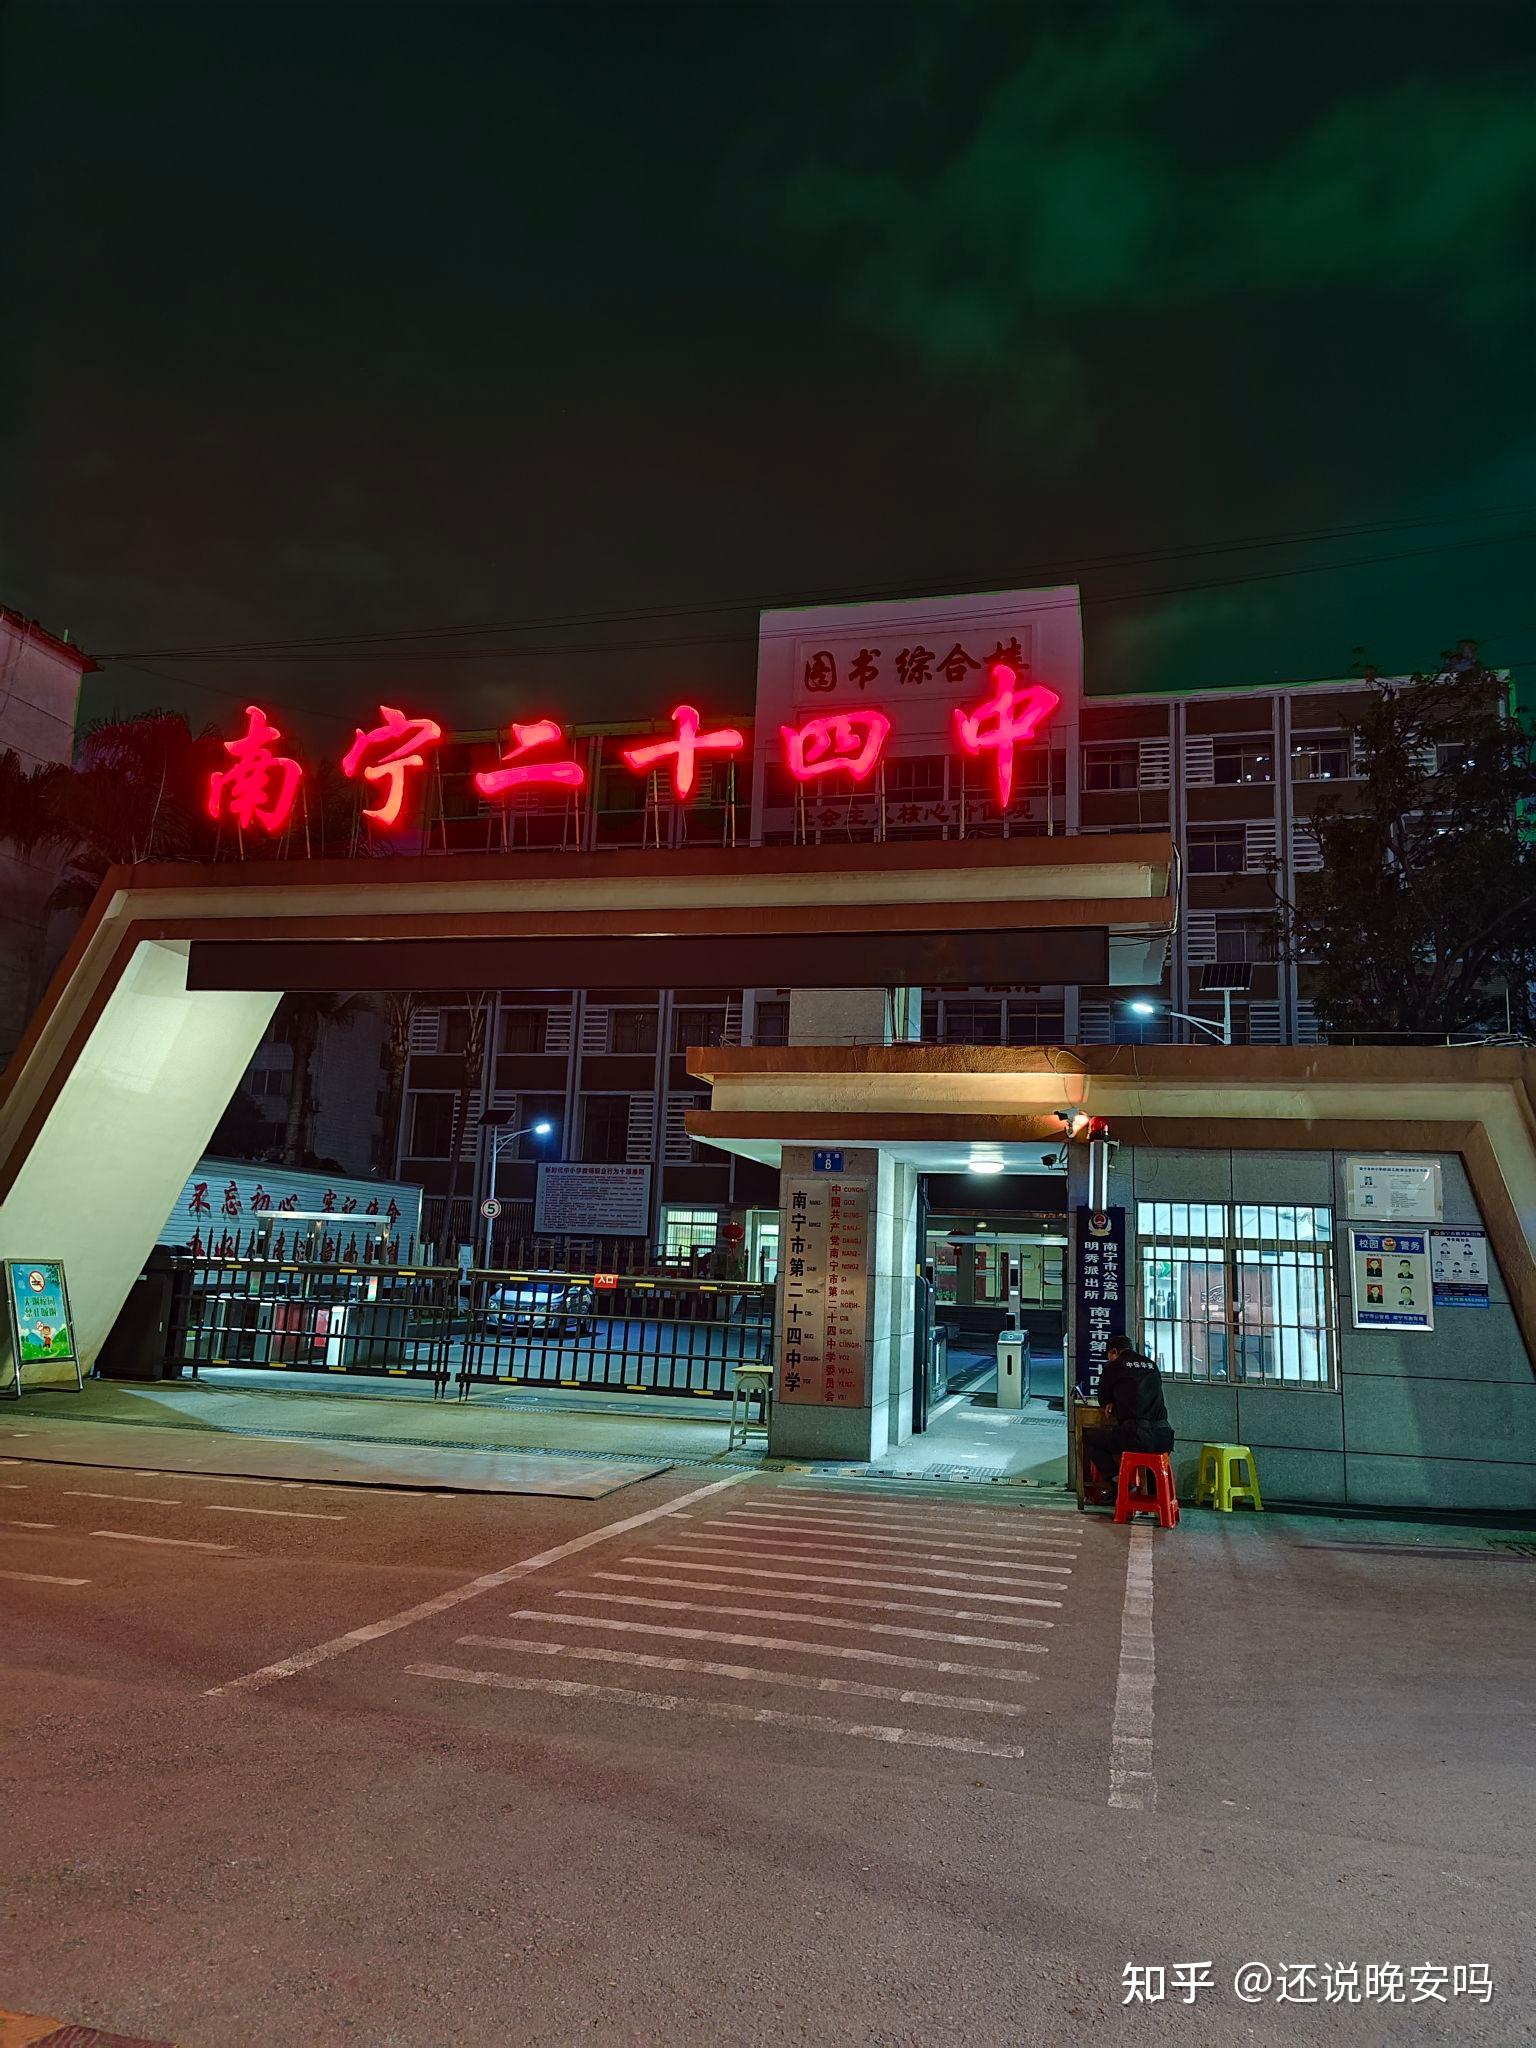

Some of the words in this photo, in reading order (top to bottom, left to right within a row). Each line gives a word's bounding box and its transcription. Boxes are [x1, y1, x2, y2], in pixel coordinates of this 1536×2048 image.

[208, 663, 1061, 830] 南宁二十四中
[825, 1159, 832, 1170] 8
[487, 1203, 496, 1215] 5
[1084, 1241, 1099, 1300] 明秀派出所
[1103, 1242, 1118, 1300] 南宁市公安局
[1359, 1239, 1379, 1249] 校园
[1400, 1240, 1420, 1251] 警务
[597, 1275, 614, 1284] 入口
[785, 1190, 808, 1392] 南宁市第二十四中学
[825, 1184, 842, 1402] 中国共产党南宁市第二十四中学委员会
